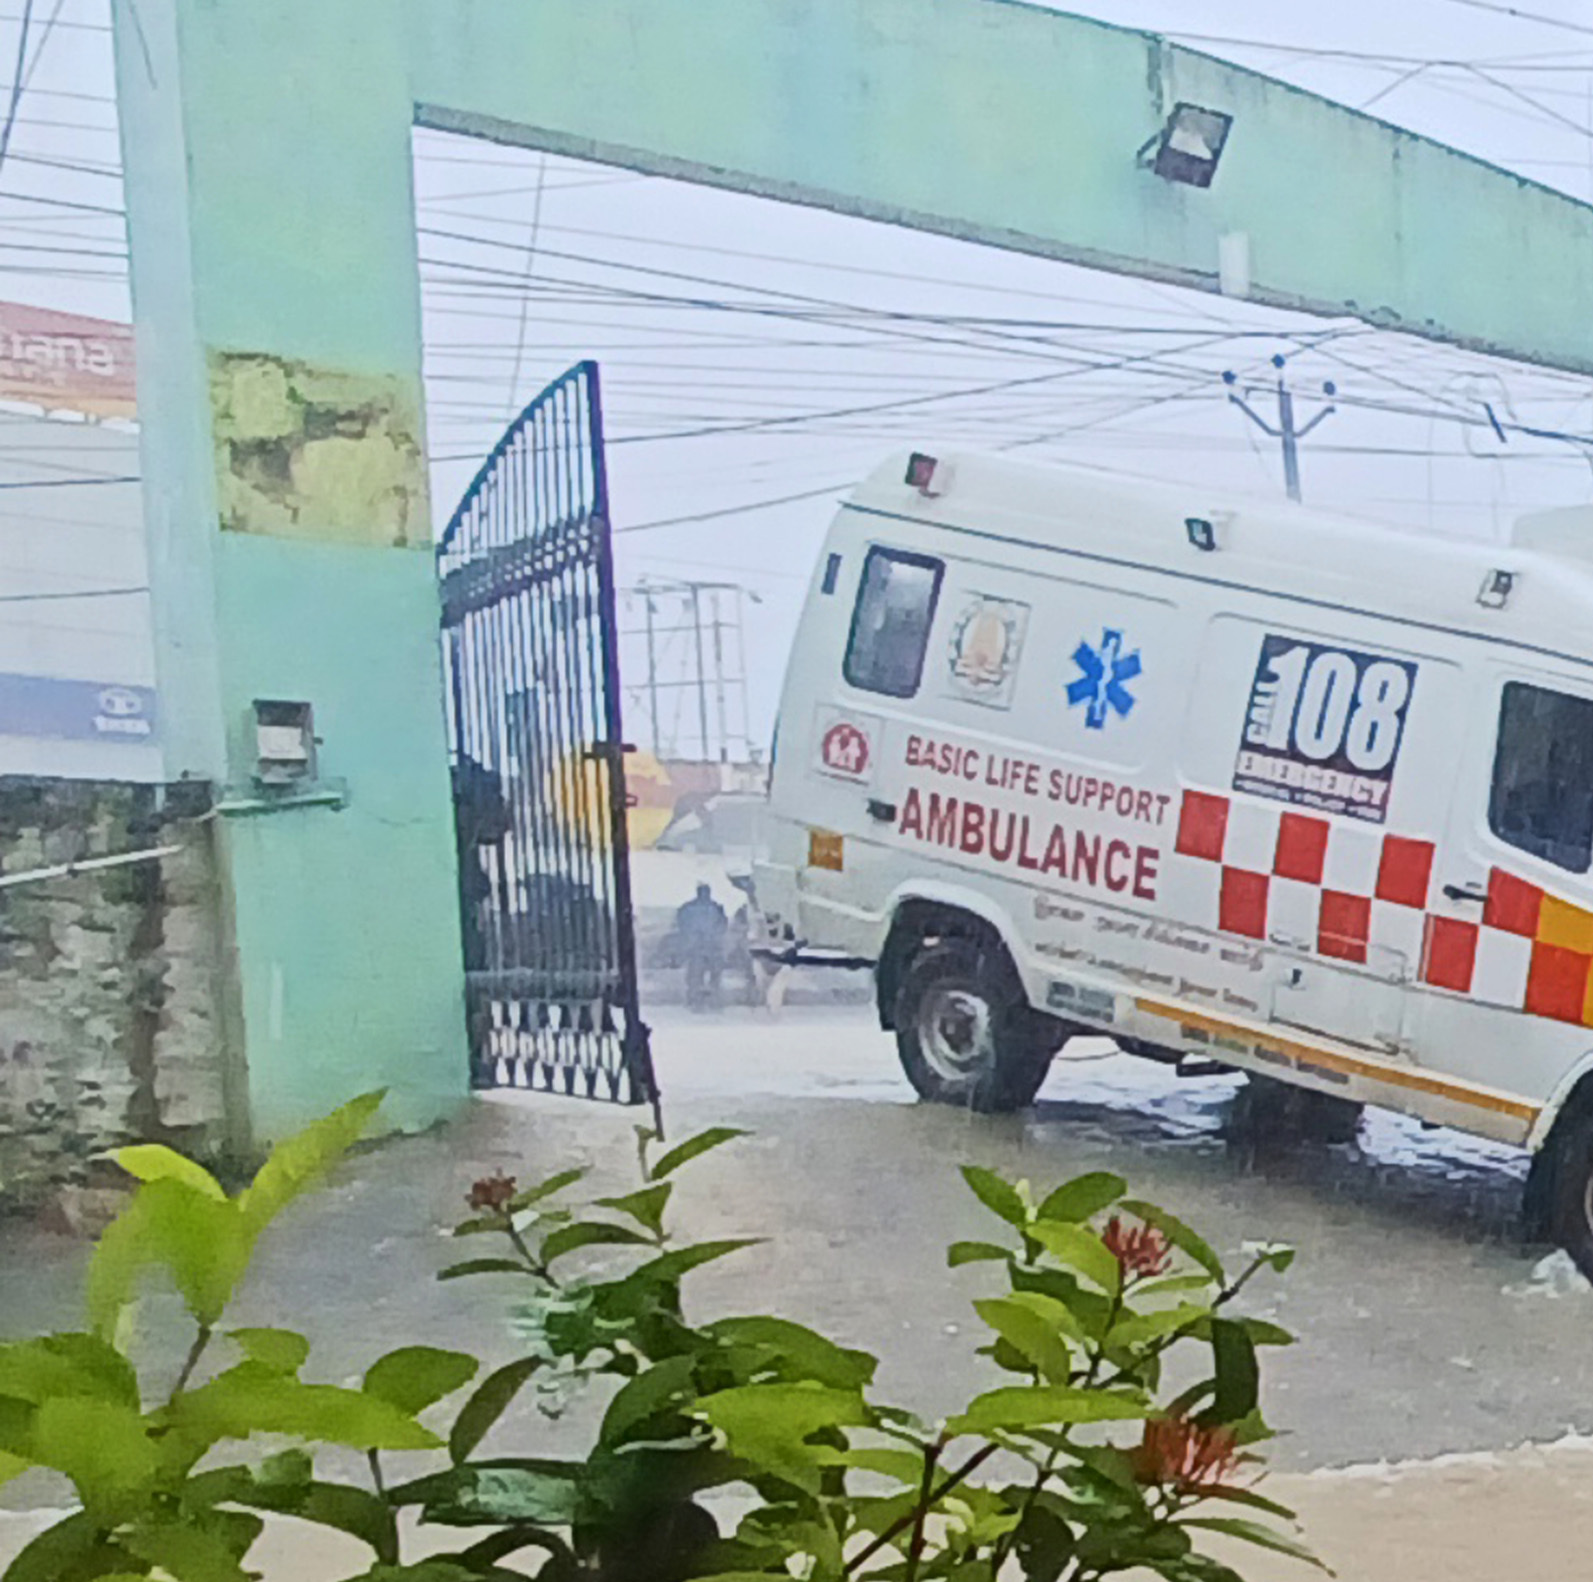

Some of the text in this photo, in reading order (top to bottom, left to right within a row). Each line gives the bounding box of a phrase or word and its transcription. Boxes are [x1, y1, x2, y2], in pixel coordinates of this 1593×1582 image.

[1265, 645, 1410, 771] 108
[905, 734, 1171, 825] BASIC LIFE SUPPORT
[899, 787, 1160, 901] AMBULANCE
